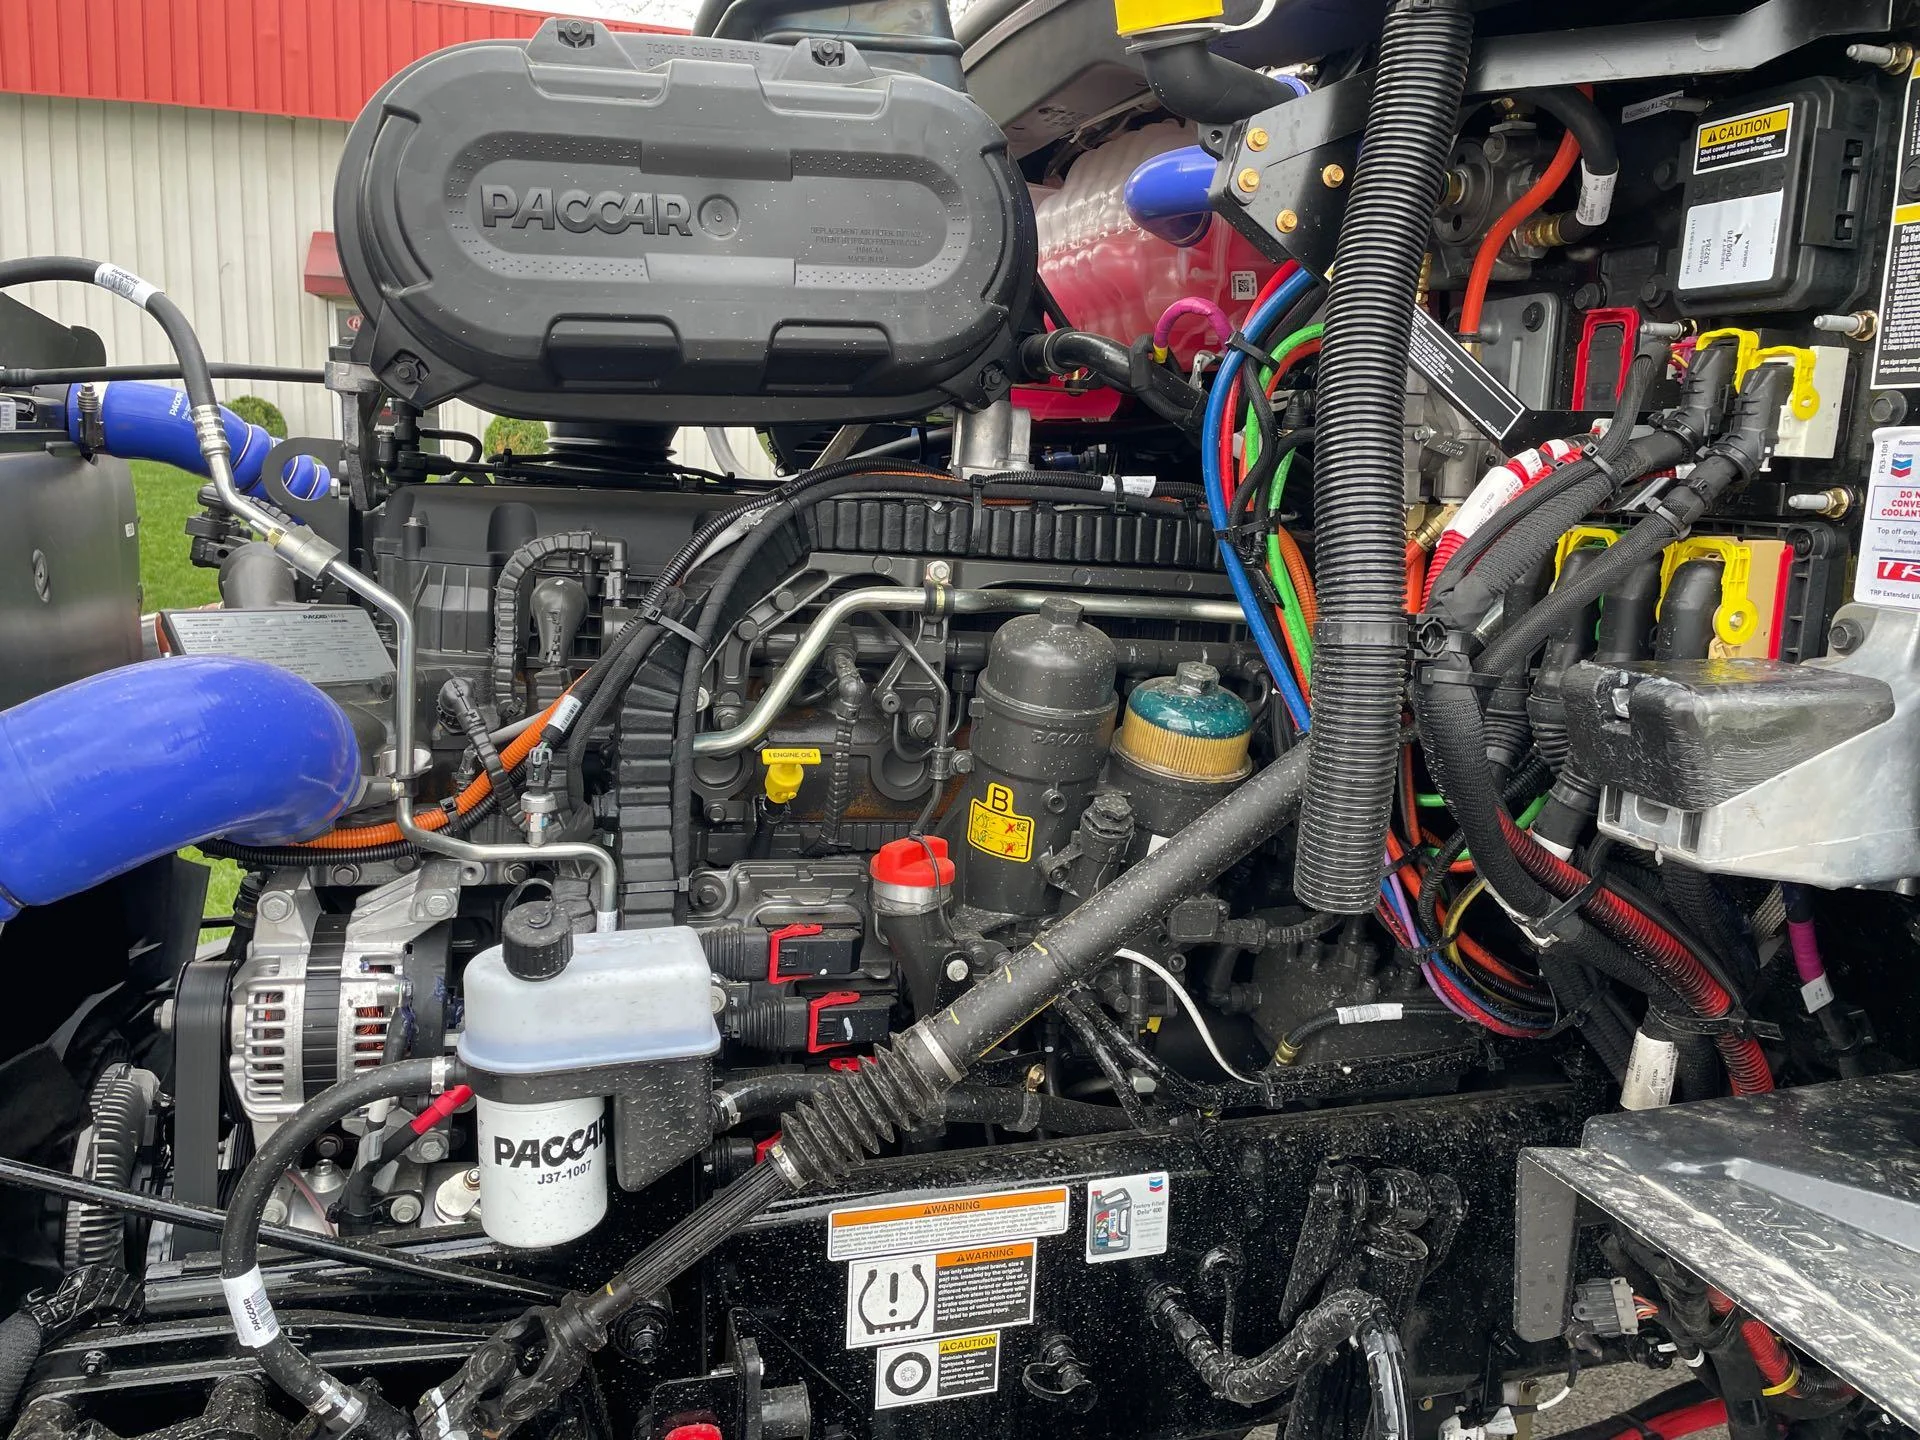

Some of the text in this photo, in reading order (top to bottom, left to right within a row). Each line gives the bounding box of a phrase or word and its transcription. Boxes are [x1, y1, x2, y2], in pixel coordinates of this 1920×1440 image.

[691, 46, 723, 58] COVER
[730, 49, 760, 61] BOLTS
[1719, 117, 1771, 140] CAUTION
[1712, 144, 1726, 152] cover
[1755, 134, 1775, 143] Engage
[1716, 151, 1729, 159] avoid
[481, 184, 693, 236] PACCAR
[1900, 491, 1912, 499] DO
[1877, 526, 1890, 534] Top
[1883, 591, 1910, 599] Extended
[992, 787, 1008, 811] B
[537, 1159, 592, 1185] J37-1007
[931, 1200, 980, 1214] WARNING
[965, 1248, 1014, 1261] WARNING
[950, 1267, 962, 1275] only
[1001, 1267, 1022, 1275] original
[967, 1275, 1004, 1284] manufacturer.
[958, 1297, 988, 1306] component
[243, 1297, 262, 1331] PACCAR
[968, 1308, 992, 1317] personal
[992, 1306, 1009, 1314] injury.
[949, 1336, 996, 1351] CAUTION
